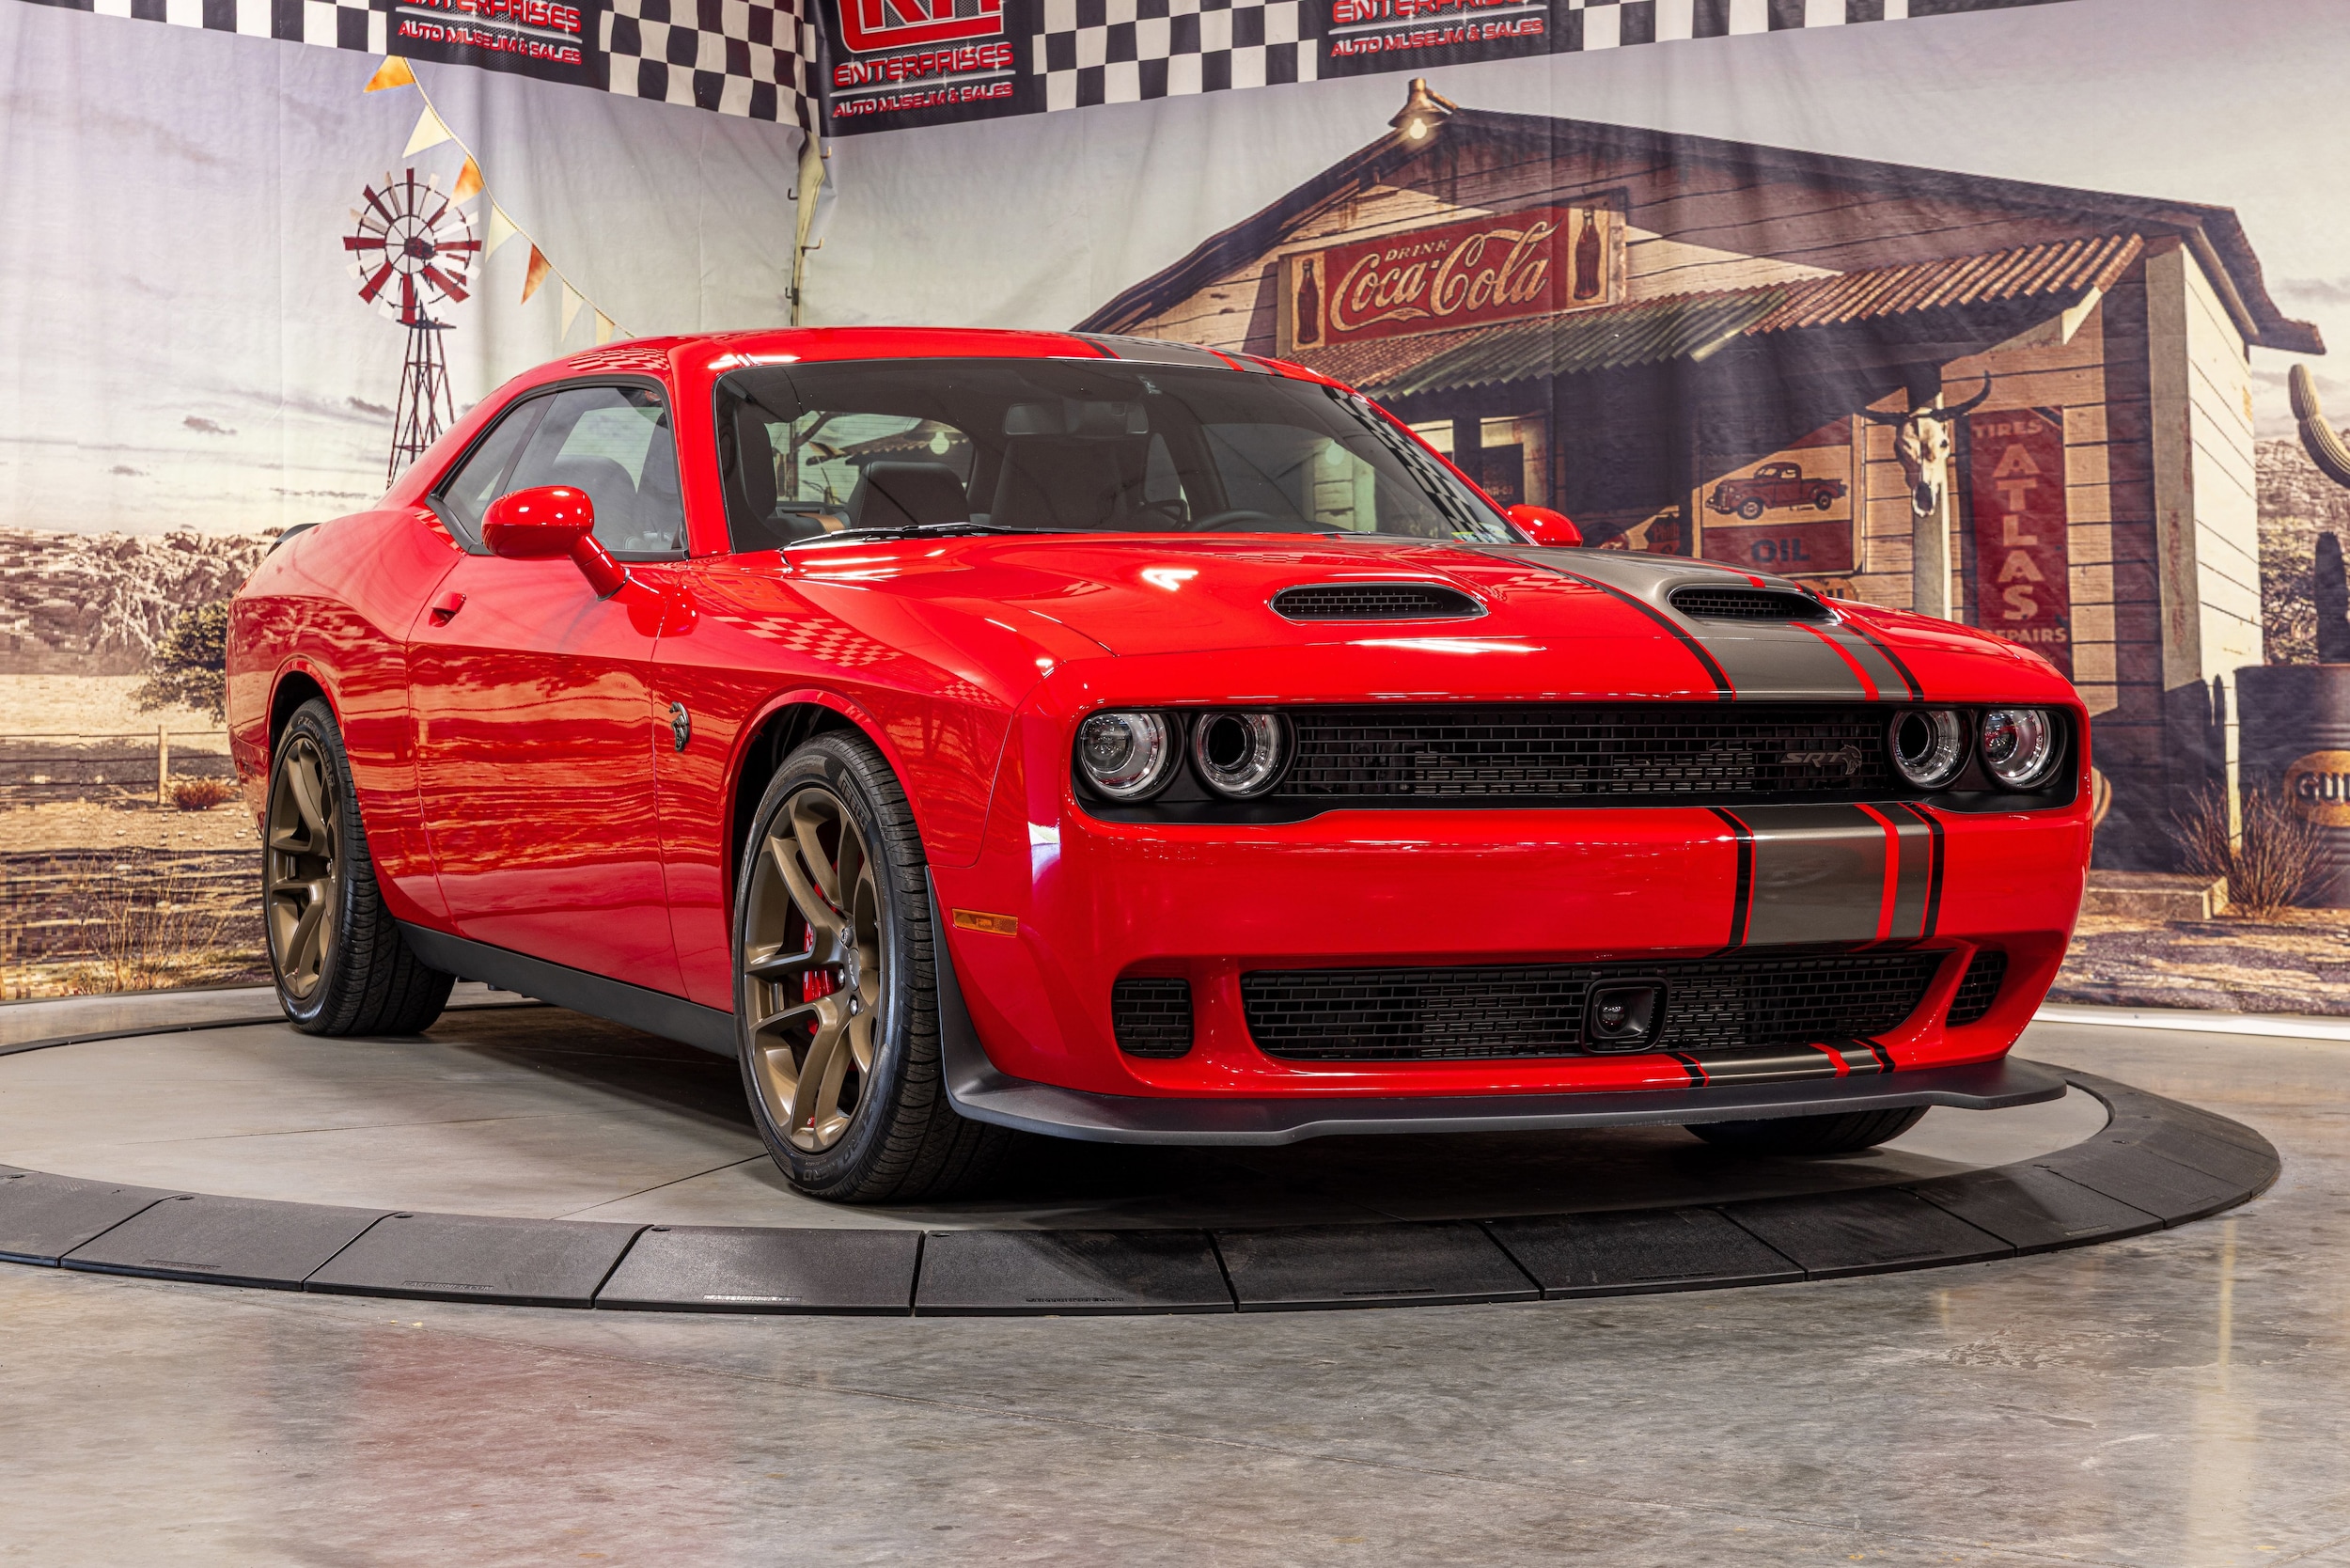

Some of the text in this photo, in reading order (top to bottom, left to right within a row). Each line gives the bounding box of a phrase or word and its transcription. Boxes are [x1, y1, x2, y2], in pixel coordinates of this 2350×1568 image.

[402, 0, 581, 33] ERPRISES
[398, 20, 582, 66] AUTO MUSEUM & SALES
[1330, 18, 1544, 57] AUTO MUSEUM & SALES
[834, 41, 1014, 87] ENTERPRISES
[832, 82, 1014, 118] AUTO MUSEUM & SALES
[1384, 239, 1450, 262] DRINK
[1329, 218, 1559, 332] Coca-Cola
[1971, 418, 2044, 439] TIRES
[1992, 443, 2044, 620] ATLAS
[1751, 538, 1810, 563] OIL
[1985, 627, 2067, 643] EPAIRS
[304, 717, 321, 740] ZERO
[1780, 751, 1846, 768] SRT
